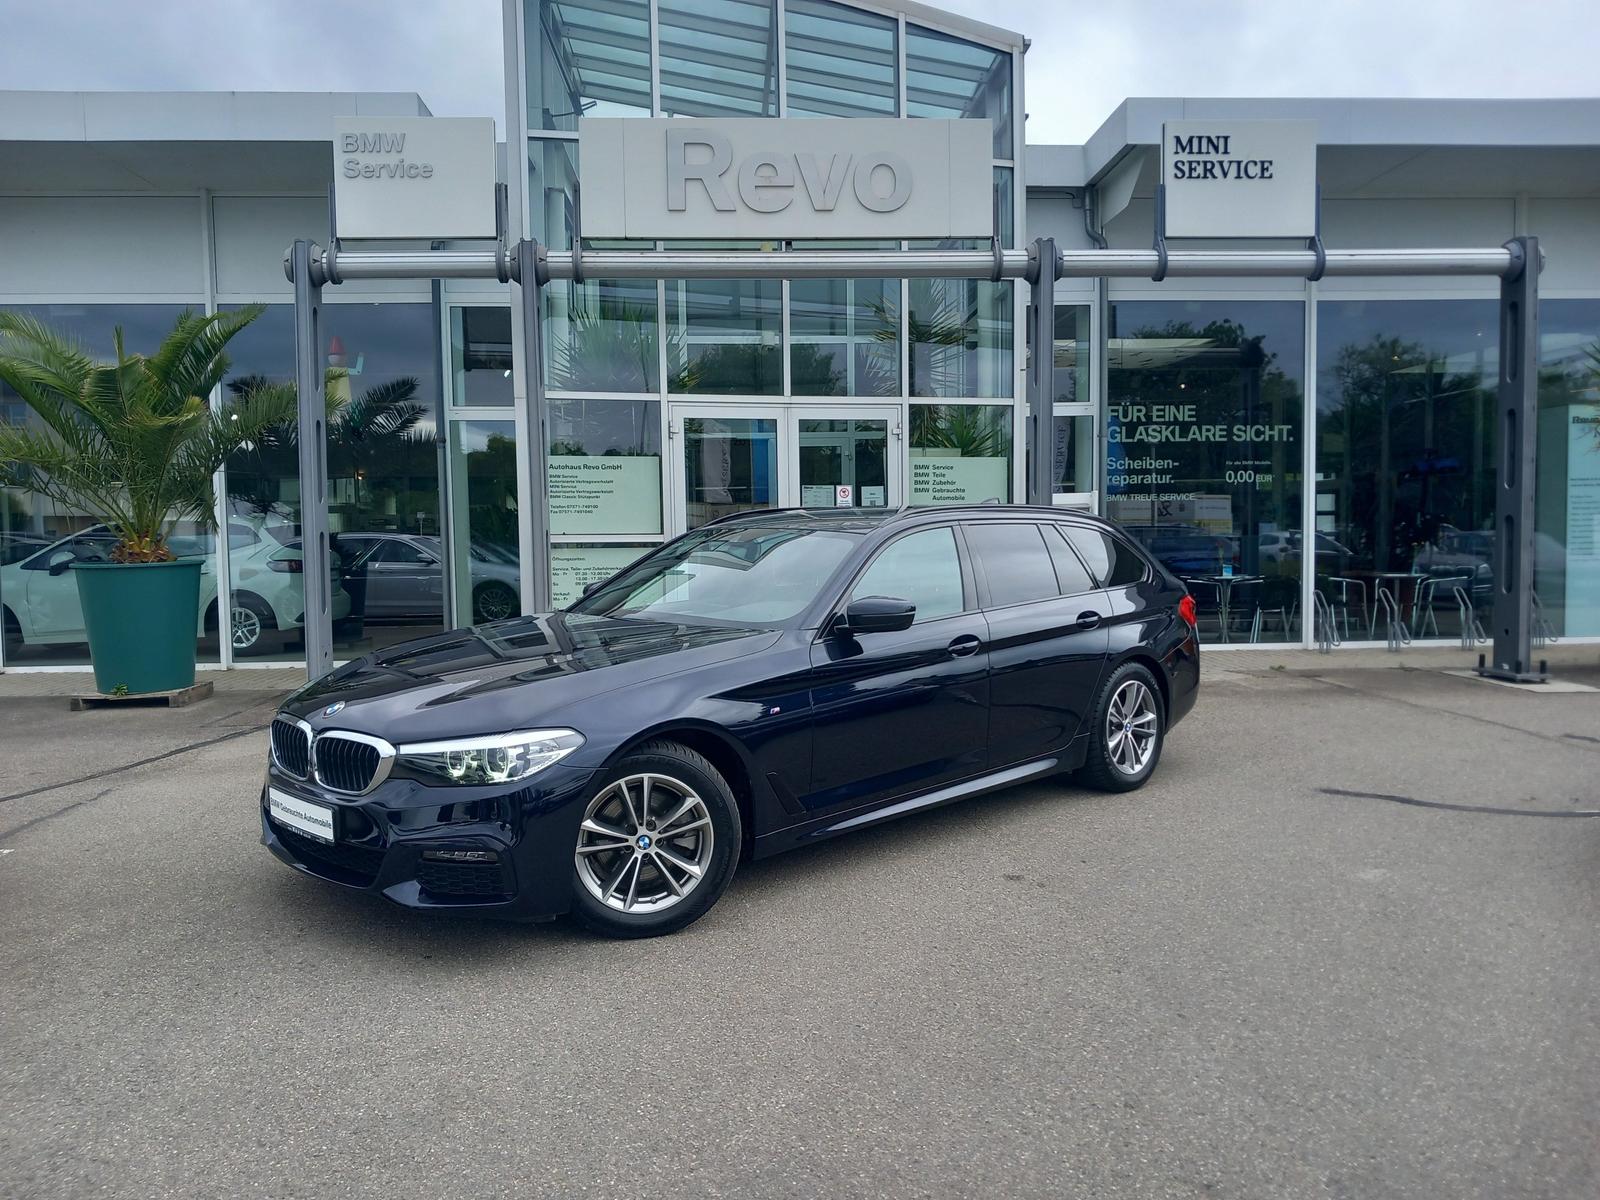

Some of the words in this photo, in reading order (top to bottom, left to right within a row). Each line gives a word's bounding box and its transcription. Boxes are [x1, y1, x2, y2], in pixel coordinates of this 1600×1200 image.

[342, 132, 406, 153] BMW
[1173, 135, 1231, 155] MINI
[343, 158, 434, 179] Service
[665, 128, 914, 213] Revo
[1173, 159, 1274, 179] SERVICE
[1107, 402, 1147, 422] FÜR
[1152, 404, 1197, 422] EINE
[1107, 424, 1228, 443] GLASKLARE
[1232, 424, 1294, 442] SICHT.
[548, 463, 582, 471] Autohaus
[583, 463, 600, 471] Revo
[600, 463, 623, 471] GmbH
[1107, 456, 1180, 470] Scheiben-
[1107, 472, 1175, 487] reparatur.
[1225, 470, 1255, 486] 0,00
[1107, 494, 1128, 502] BMW
[1159, 493, 1195, 501] SERVICE
